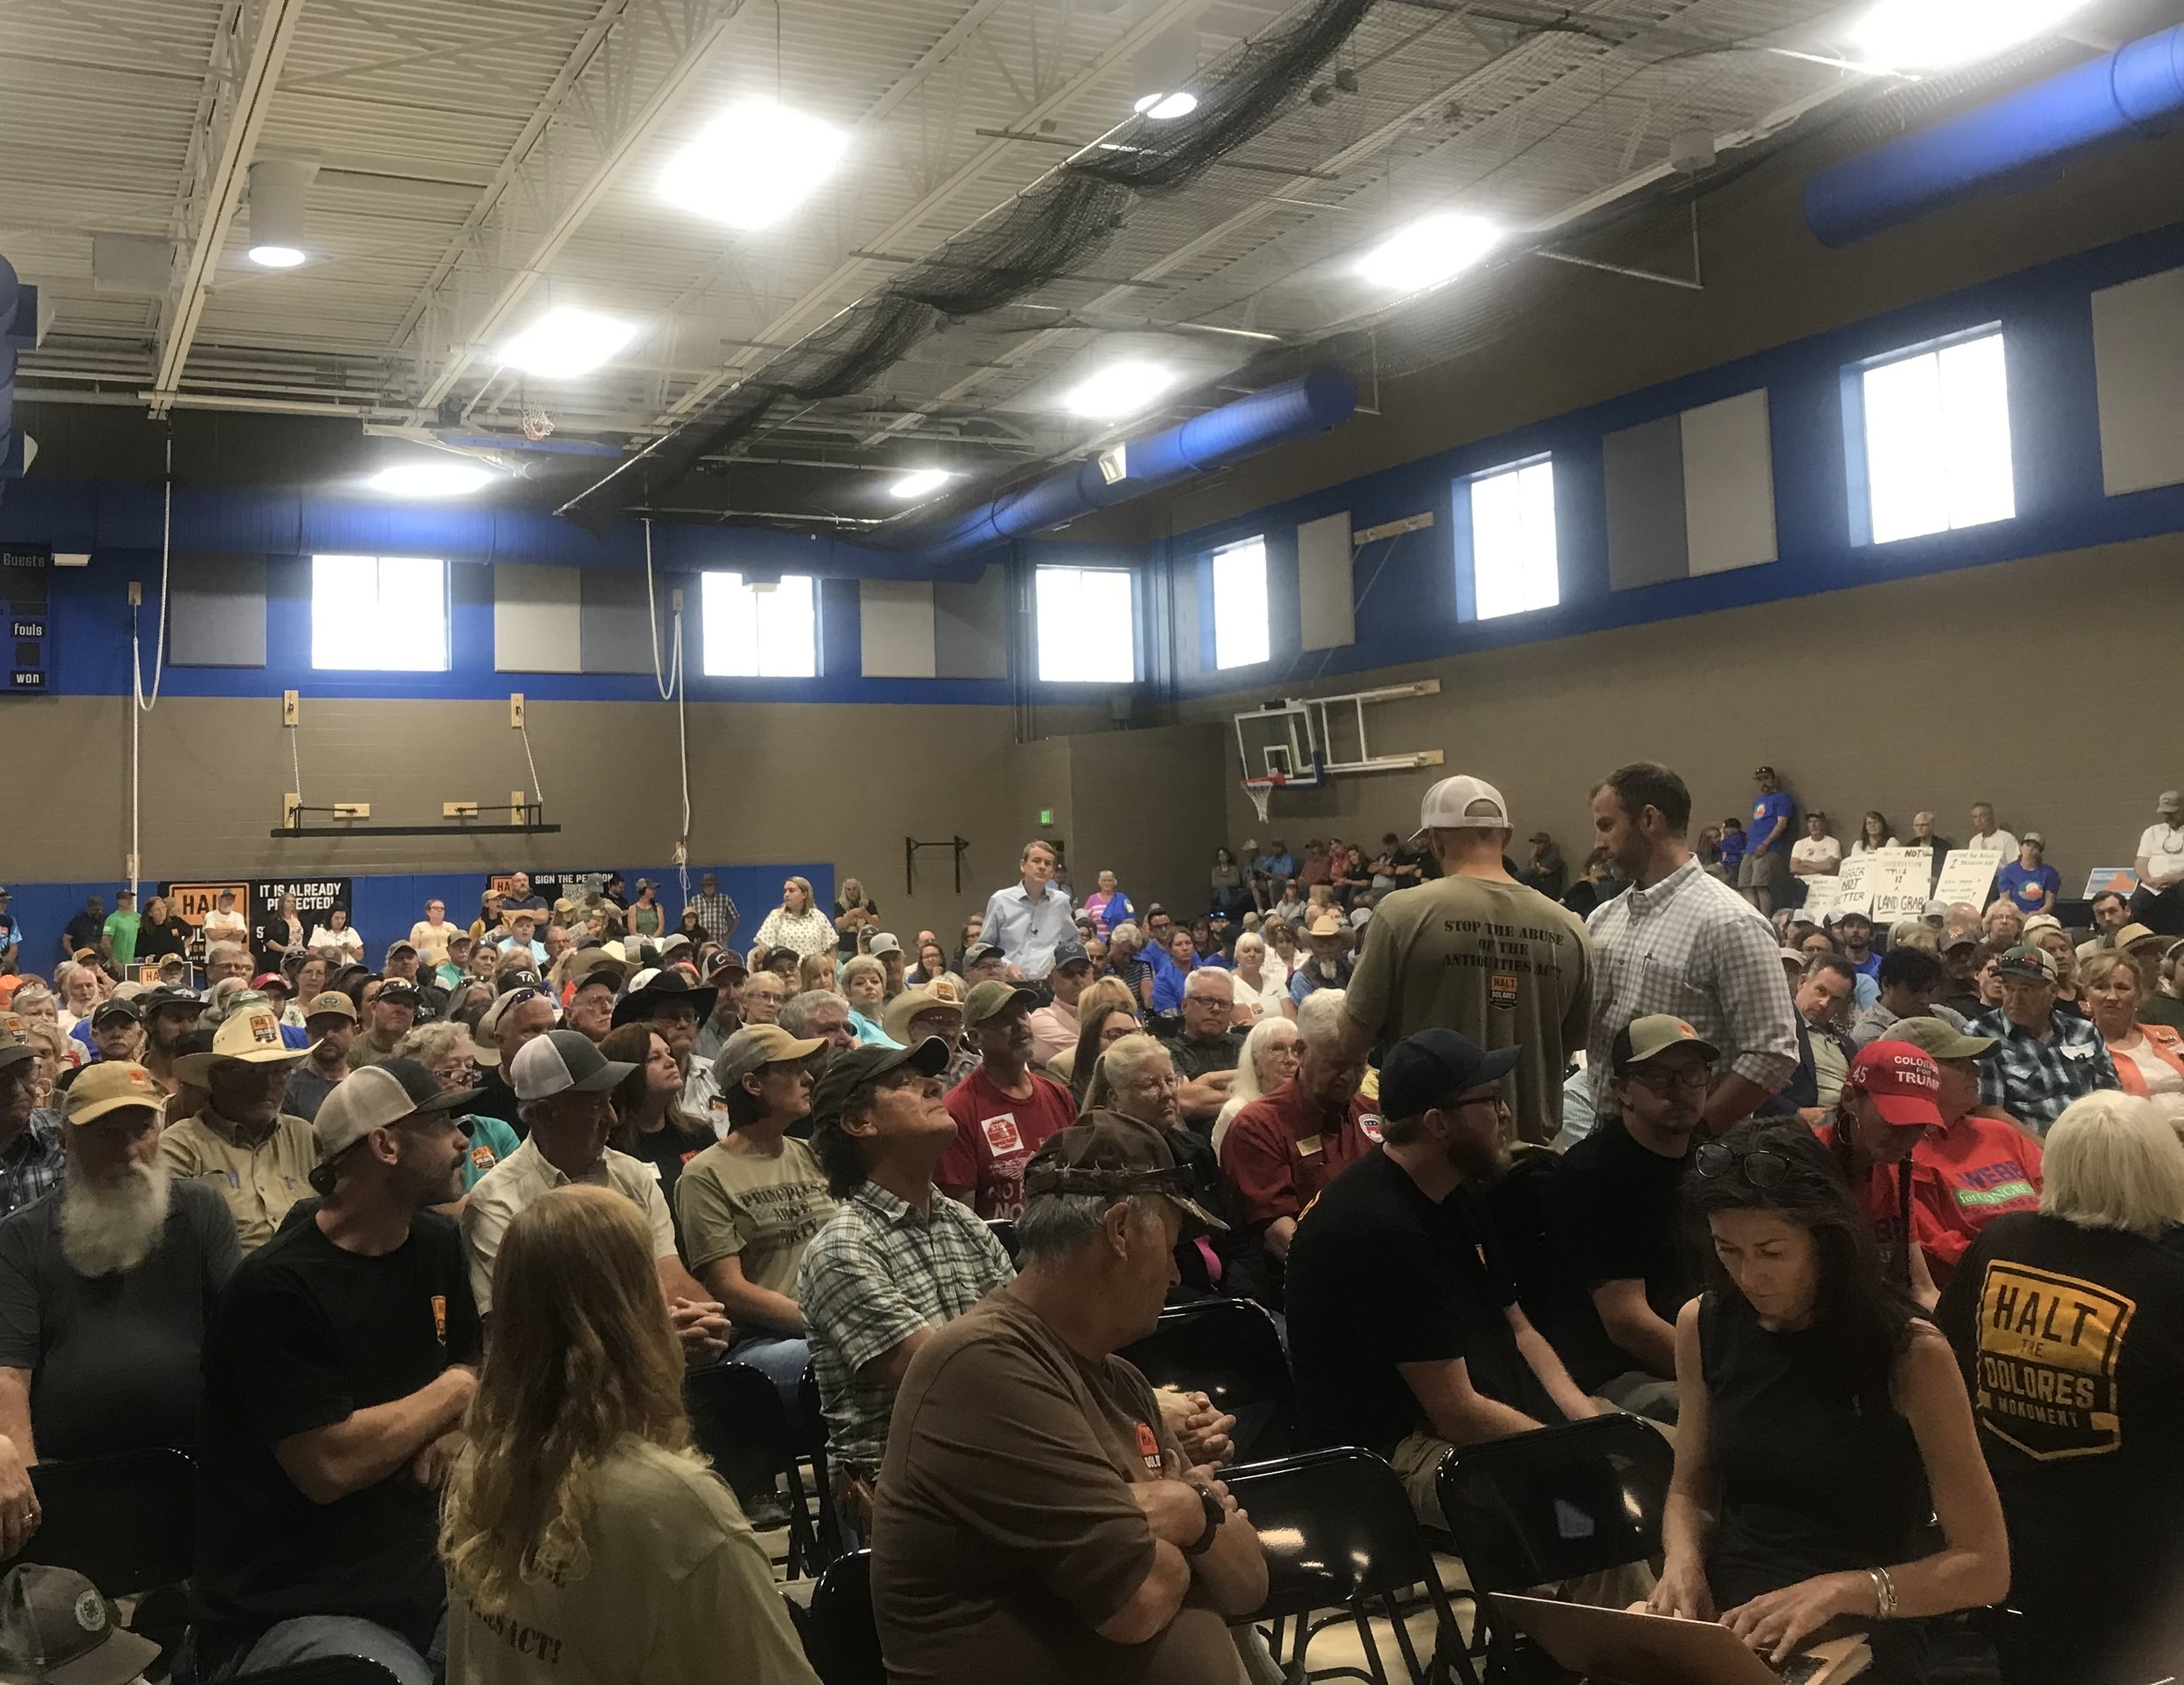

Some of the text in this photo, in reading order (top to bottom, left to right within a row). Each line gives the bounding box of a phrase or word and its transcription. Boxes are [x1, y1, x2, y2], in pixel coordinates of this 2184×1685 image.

[3, 553, 45, 567] Guests
[14, 623, 43, 636] fouls
[16, 673, 40, 684] won
[1904, 849, 1922, 858] NOT
[535, 874, 556, 885] SIGN
[557, 874, 573, 883] THE
[1842, 878, 1862, 890] NOT
[259, 882, 342, 898] IT IS ALREADY
[1444, 920, 1565, 946] STOP THE ABUSE
[1478, 938, 1529, 956] OF THE
[1442, 953, 1532, 973] ANTIQUITIES
[1494, 977, 1515, 989] HALT
[1852, 1065, 1869, 1083] 45
[1916, 1067, 1932, 1075] FOR
[1895, 1071, 1939, 1090] TRUMP
[1957, 1160, 2025, 1189] WEBB
[1993, 1285, 2098, 1347] HALT
[2021, 1338, 2045, 1357] THE
[1984, 1357, 2095, 1409] DOLORES
